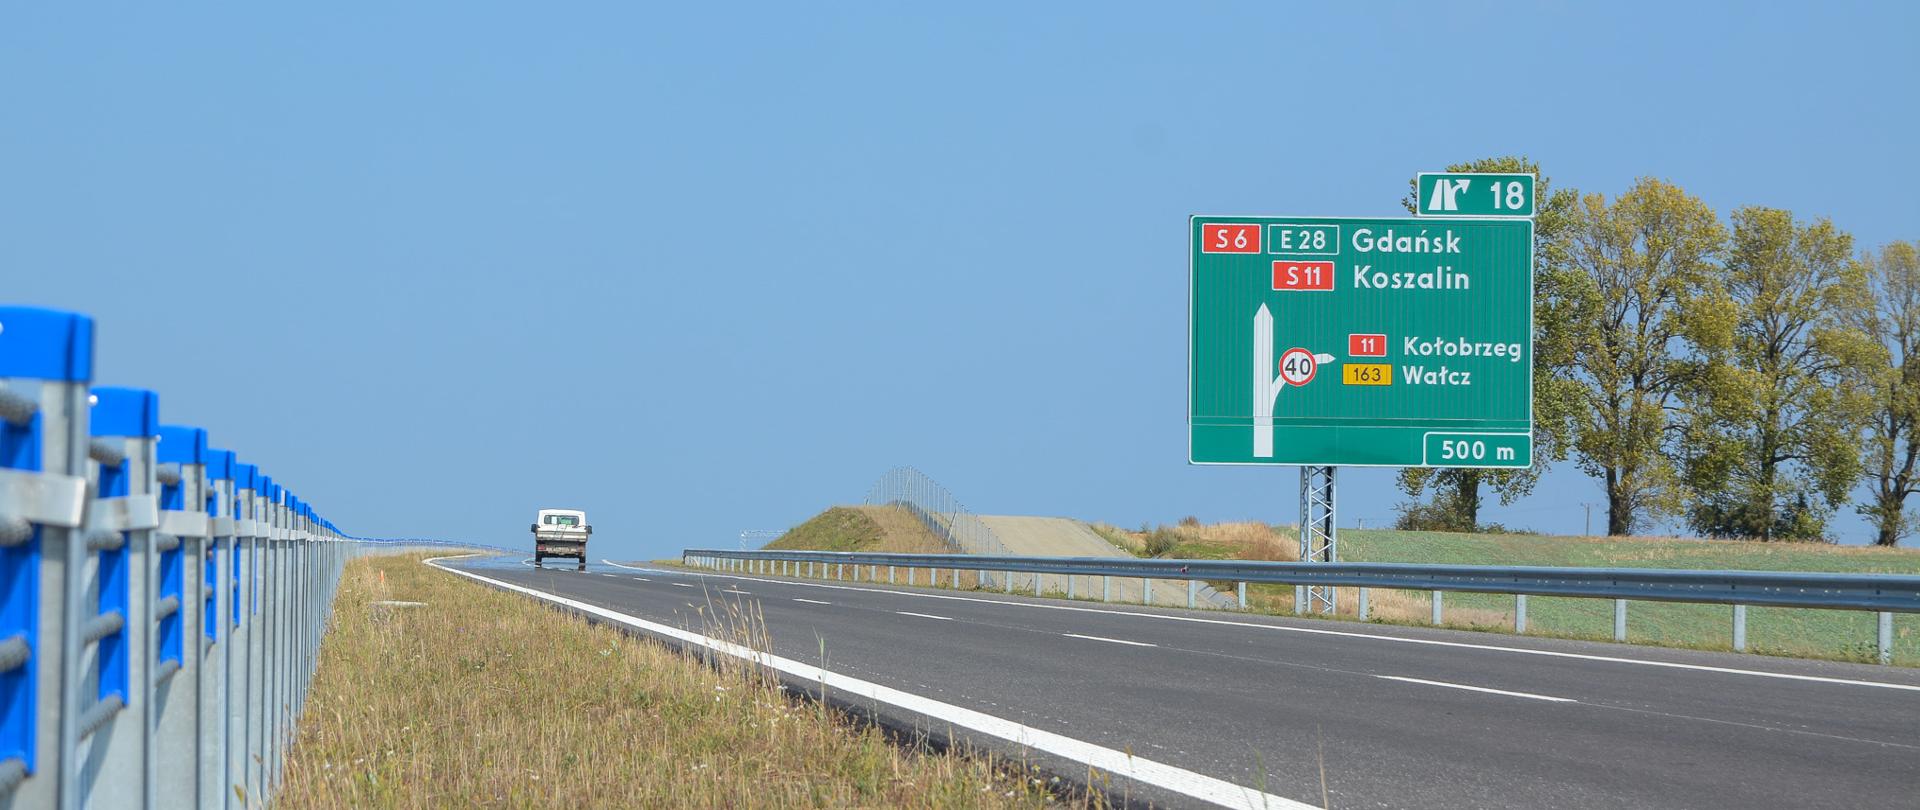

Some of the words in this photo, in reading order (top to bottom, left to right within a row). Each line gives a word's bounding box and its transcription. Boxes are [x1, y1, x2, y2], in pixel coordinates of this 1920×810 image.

[1490, 181, 1525, 210] 18
[1352, 228, 1461, 254] Gdańsk
[1353, 265, 1470, 290] Koszalin
[1360, 338, 1375, 353] 11
[1403, 336, 1522, 362] Kołobrzeg
[1285, 358, 1311, 375] 40
[1353, 367, 1382, 382] 163
[1402, 365, 1471, 386] Wałcz
[1441, 440, 1486, 460] 500
[1496, 444, 1515, 460] m
